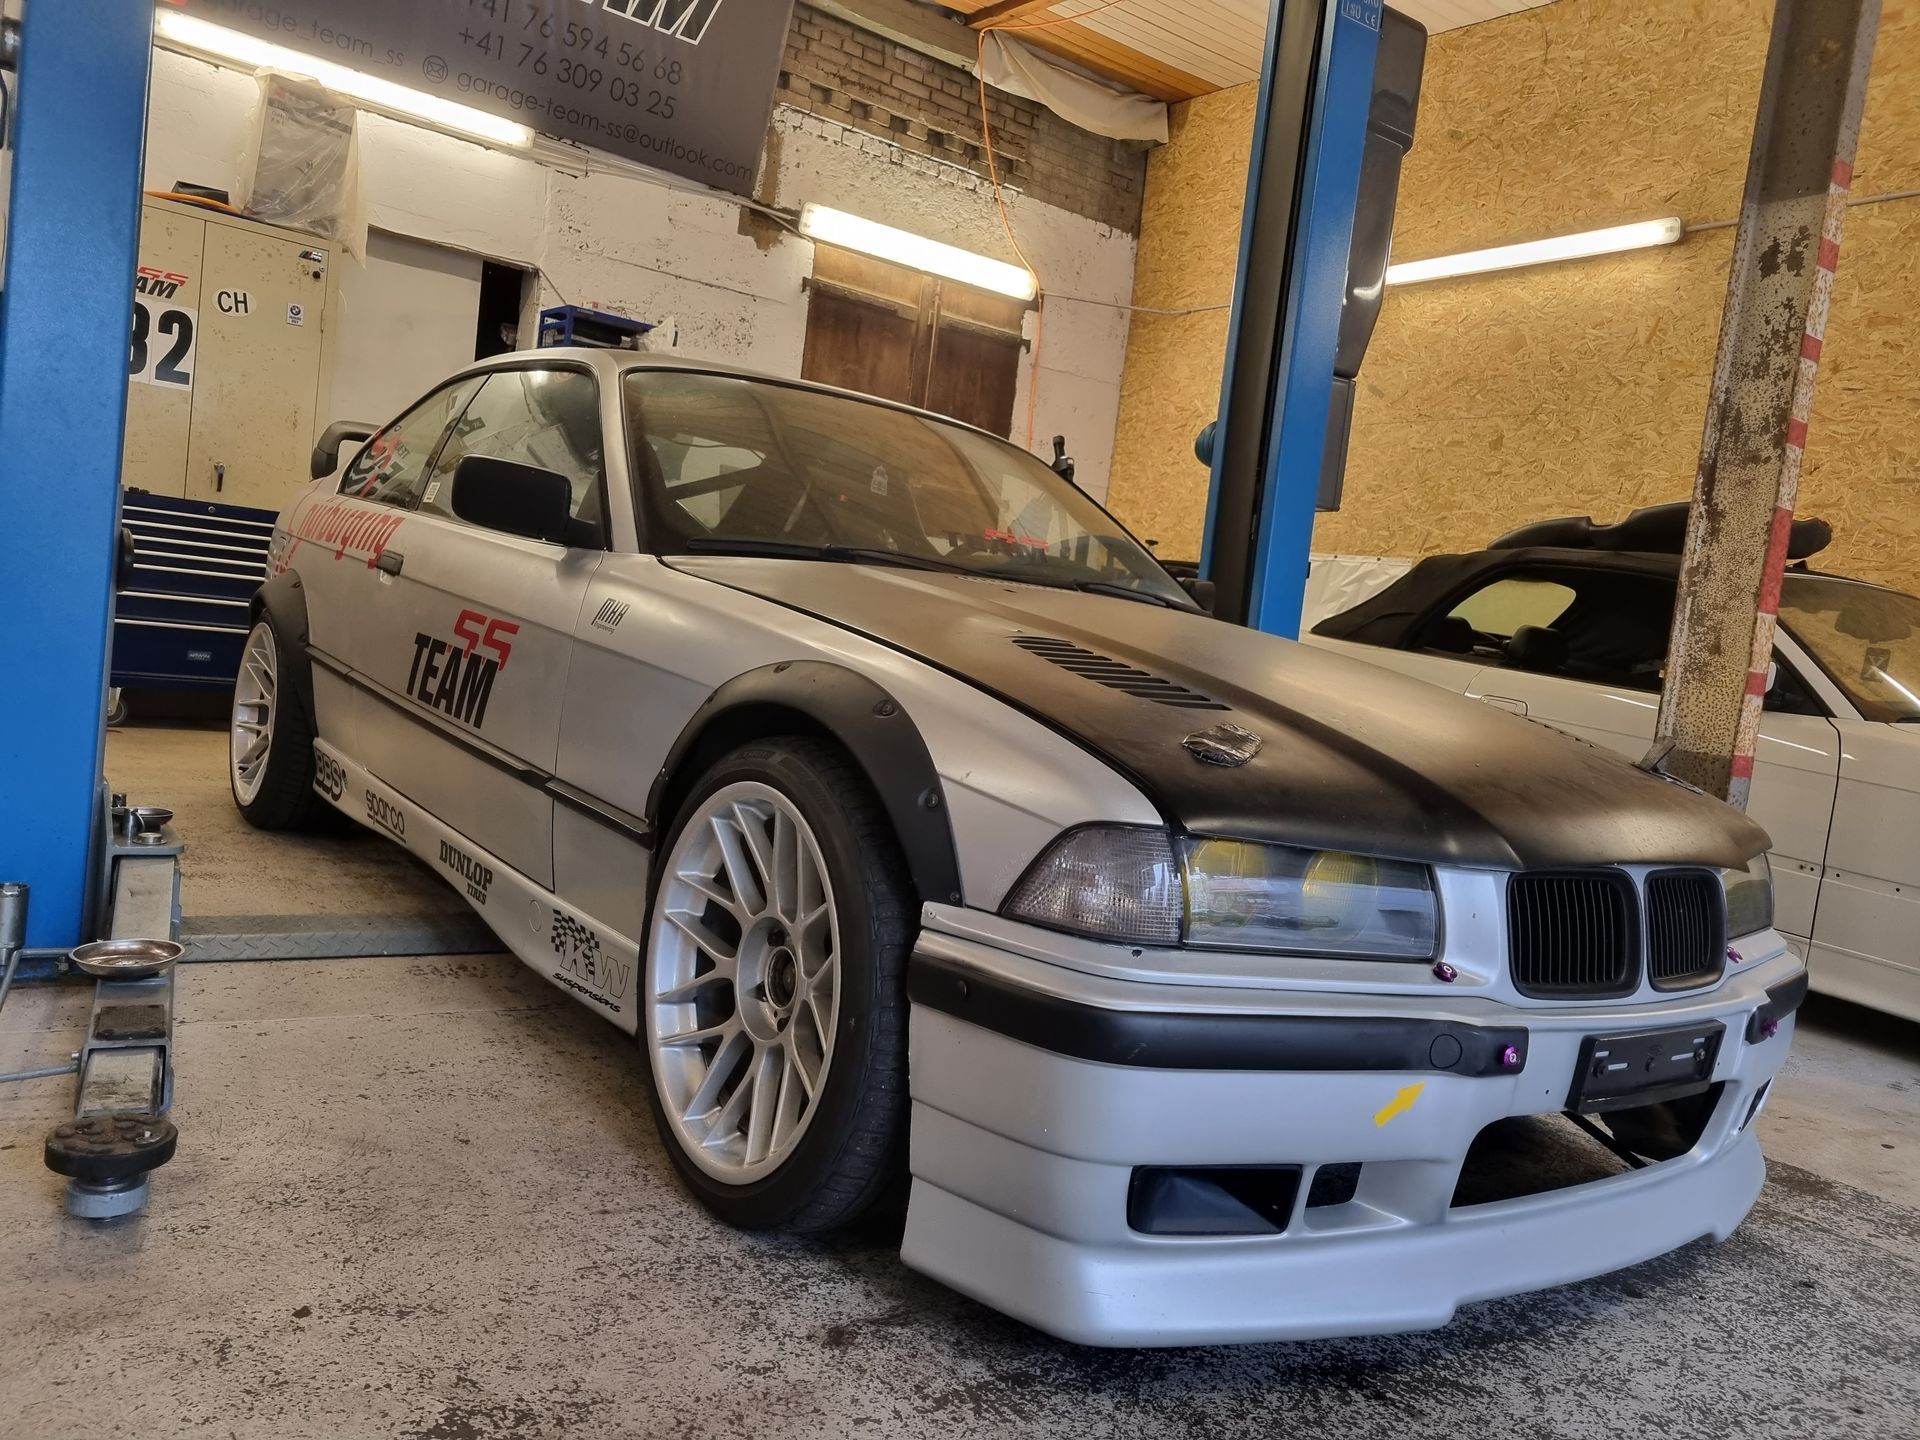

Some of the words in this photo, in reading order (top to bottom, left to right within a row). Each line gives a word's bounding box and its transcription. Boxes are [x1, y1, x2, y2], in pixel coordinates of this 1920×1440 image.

[528, 4, 554, 39] 76
[562, 22, 609, 60] 594
[616, 42, 645, 72] 56
[654, 57, 682, 85] 68
[458, 27, 504, 61] +41
[518, 42, 547, 76] 76
[557, 58, 603, 93] 309
[610, 77, 640, 107] 03
[646, 90, 677, 119] 25
[457, 72, 752, 180] garage-team-ss@outlook.com
[136, 276, 179, 299] AM
[217, 291, 249, 314] CH
[454, 609, 520, 671] SS
[406, 632, 500, 730] TEAM
[314, 747, 342, 802] BBS
[366, 789, 405, 838] sparco
[439, 839, 493, 892] DUNLOP
[467, 882, 487, 905] TIRES
[552, 972, 622, 1013] suspensions
[559, 932, 631, 999] KW
